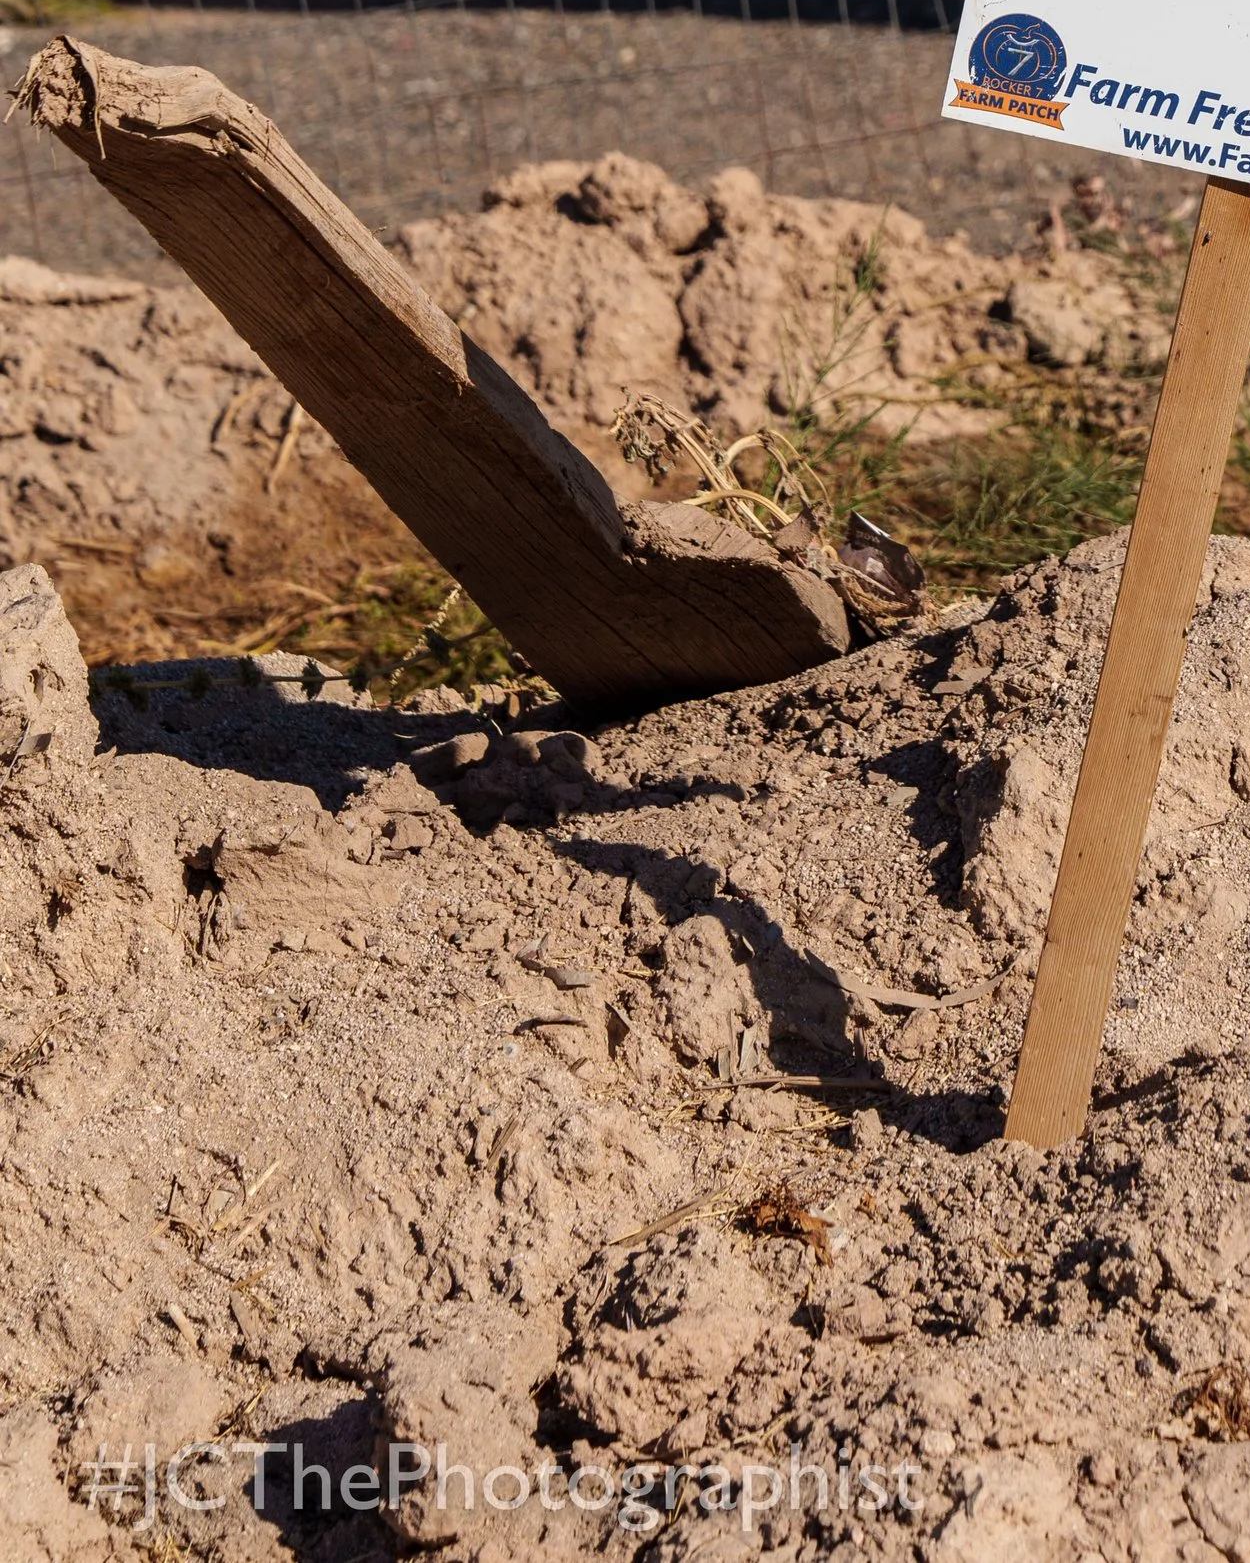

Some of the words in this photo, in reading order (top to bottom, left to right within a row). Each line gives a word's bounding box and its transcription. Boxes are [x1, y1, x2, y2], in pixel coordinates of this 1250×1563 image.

[959, 89, 1004, 109] FARM
[1008, 100, 1059, 121] PATCH
[1036, 87, 1043, 98] 7
[1064, 63, 1180, 119] Farm
